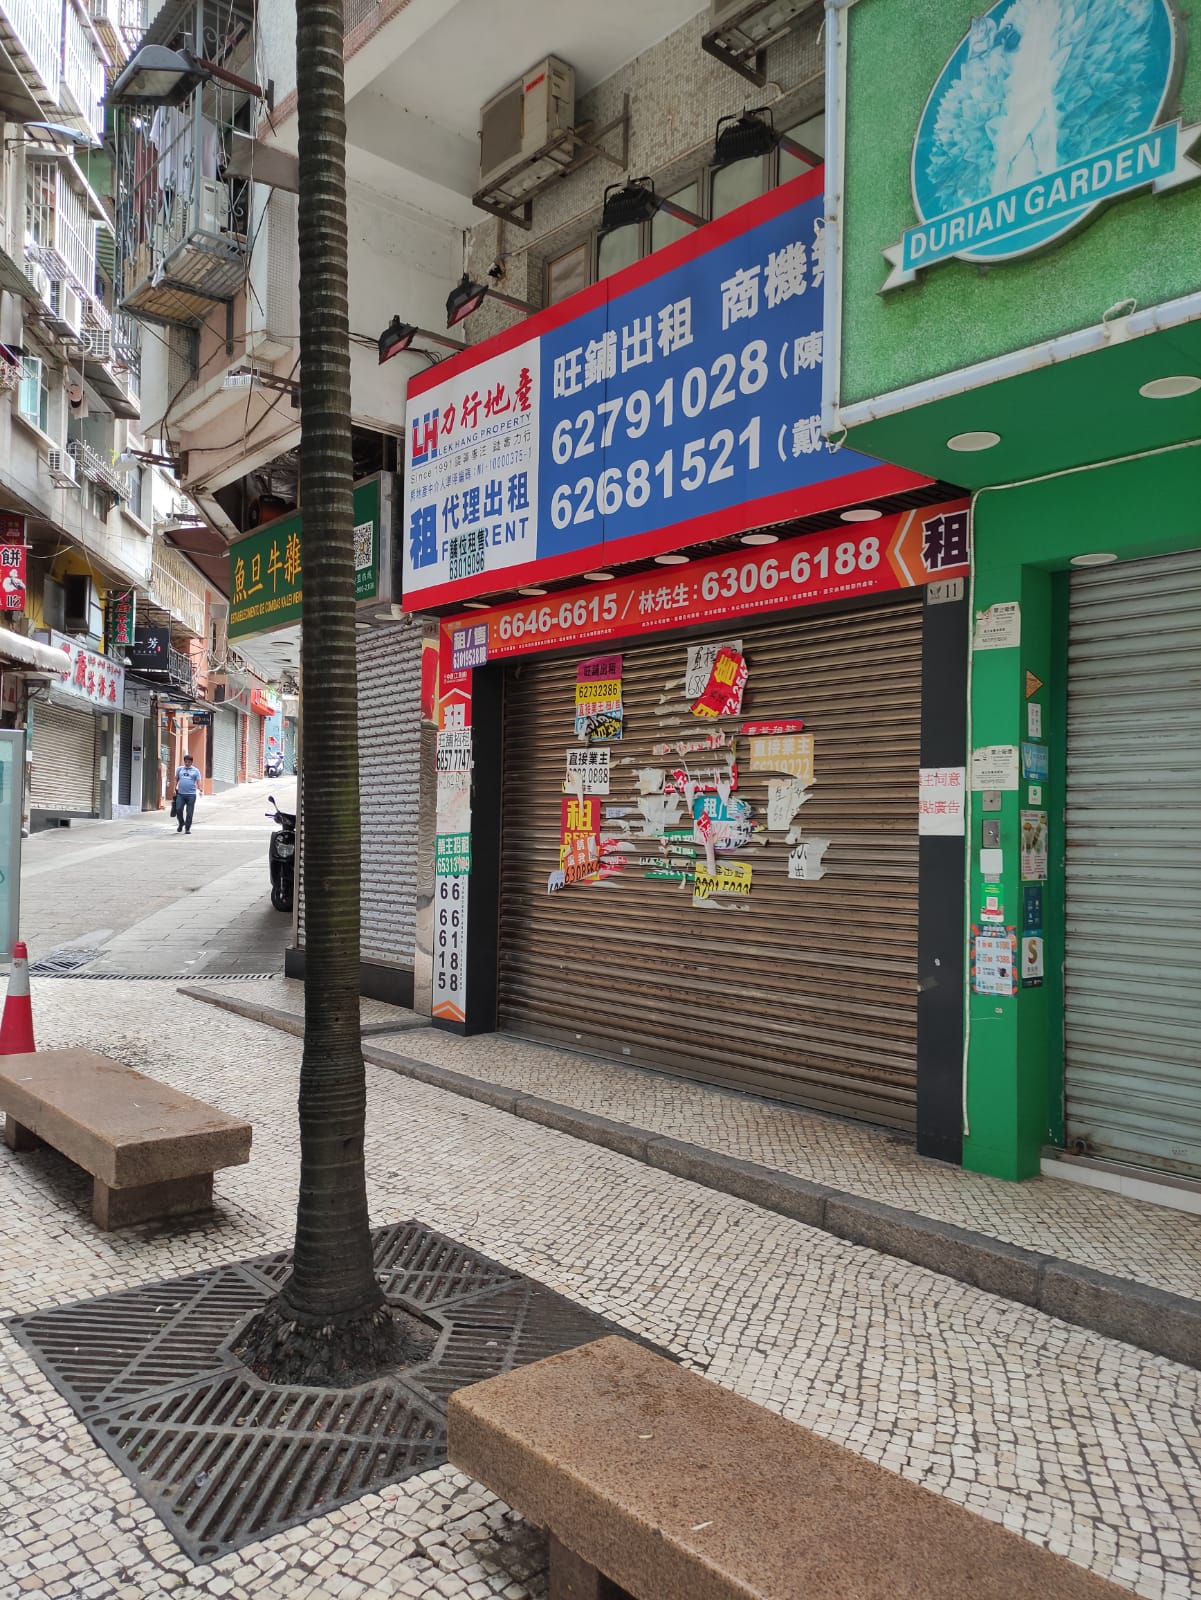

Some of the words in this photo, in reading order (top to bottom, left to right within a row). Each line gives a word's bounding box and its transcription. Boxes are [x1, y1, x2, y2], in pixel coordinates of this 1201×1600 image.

[909, 196, 1016, 260] DURIAN
[1024, 137, 1161, 216] GARDEN
[551, 339, 769, 465] 62791028
[438, 442, 453, 456] LEK
[454, 432, 478, 450] HANG
[480, 412, 532, 438] PROPERTY
[410, 469, 432, 485] Since
[550, 415, 761, 530] 62681521
[442, 471, 529, 533] 代理出租
[409, 503, 438, 570] 租
[920, 509, 970, 572] 租
[1, 547, 21, 567] 餅
[233, 532, 302, 606] 魚旦牛雜
[701, 536, 881, 601] 6306-6188
[945, 583, 959, 598] 11
[579, 684, 618, 698] 62732386
[443, 703, 466, 730] 租
[568, 751, 609, 766] 直接業主
[752, 737, 811, 757] 直接業主
[918, 771, 961, 787] 主同意
[566, 800, 593, 831] 租
